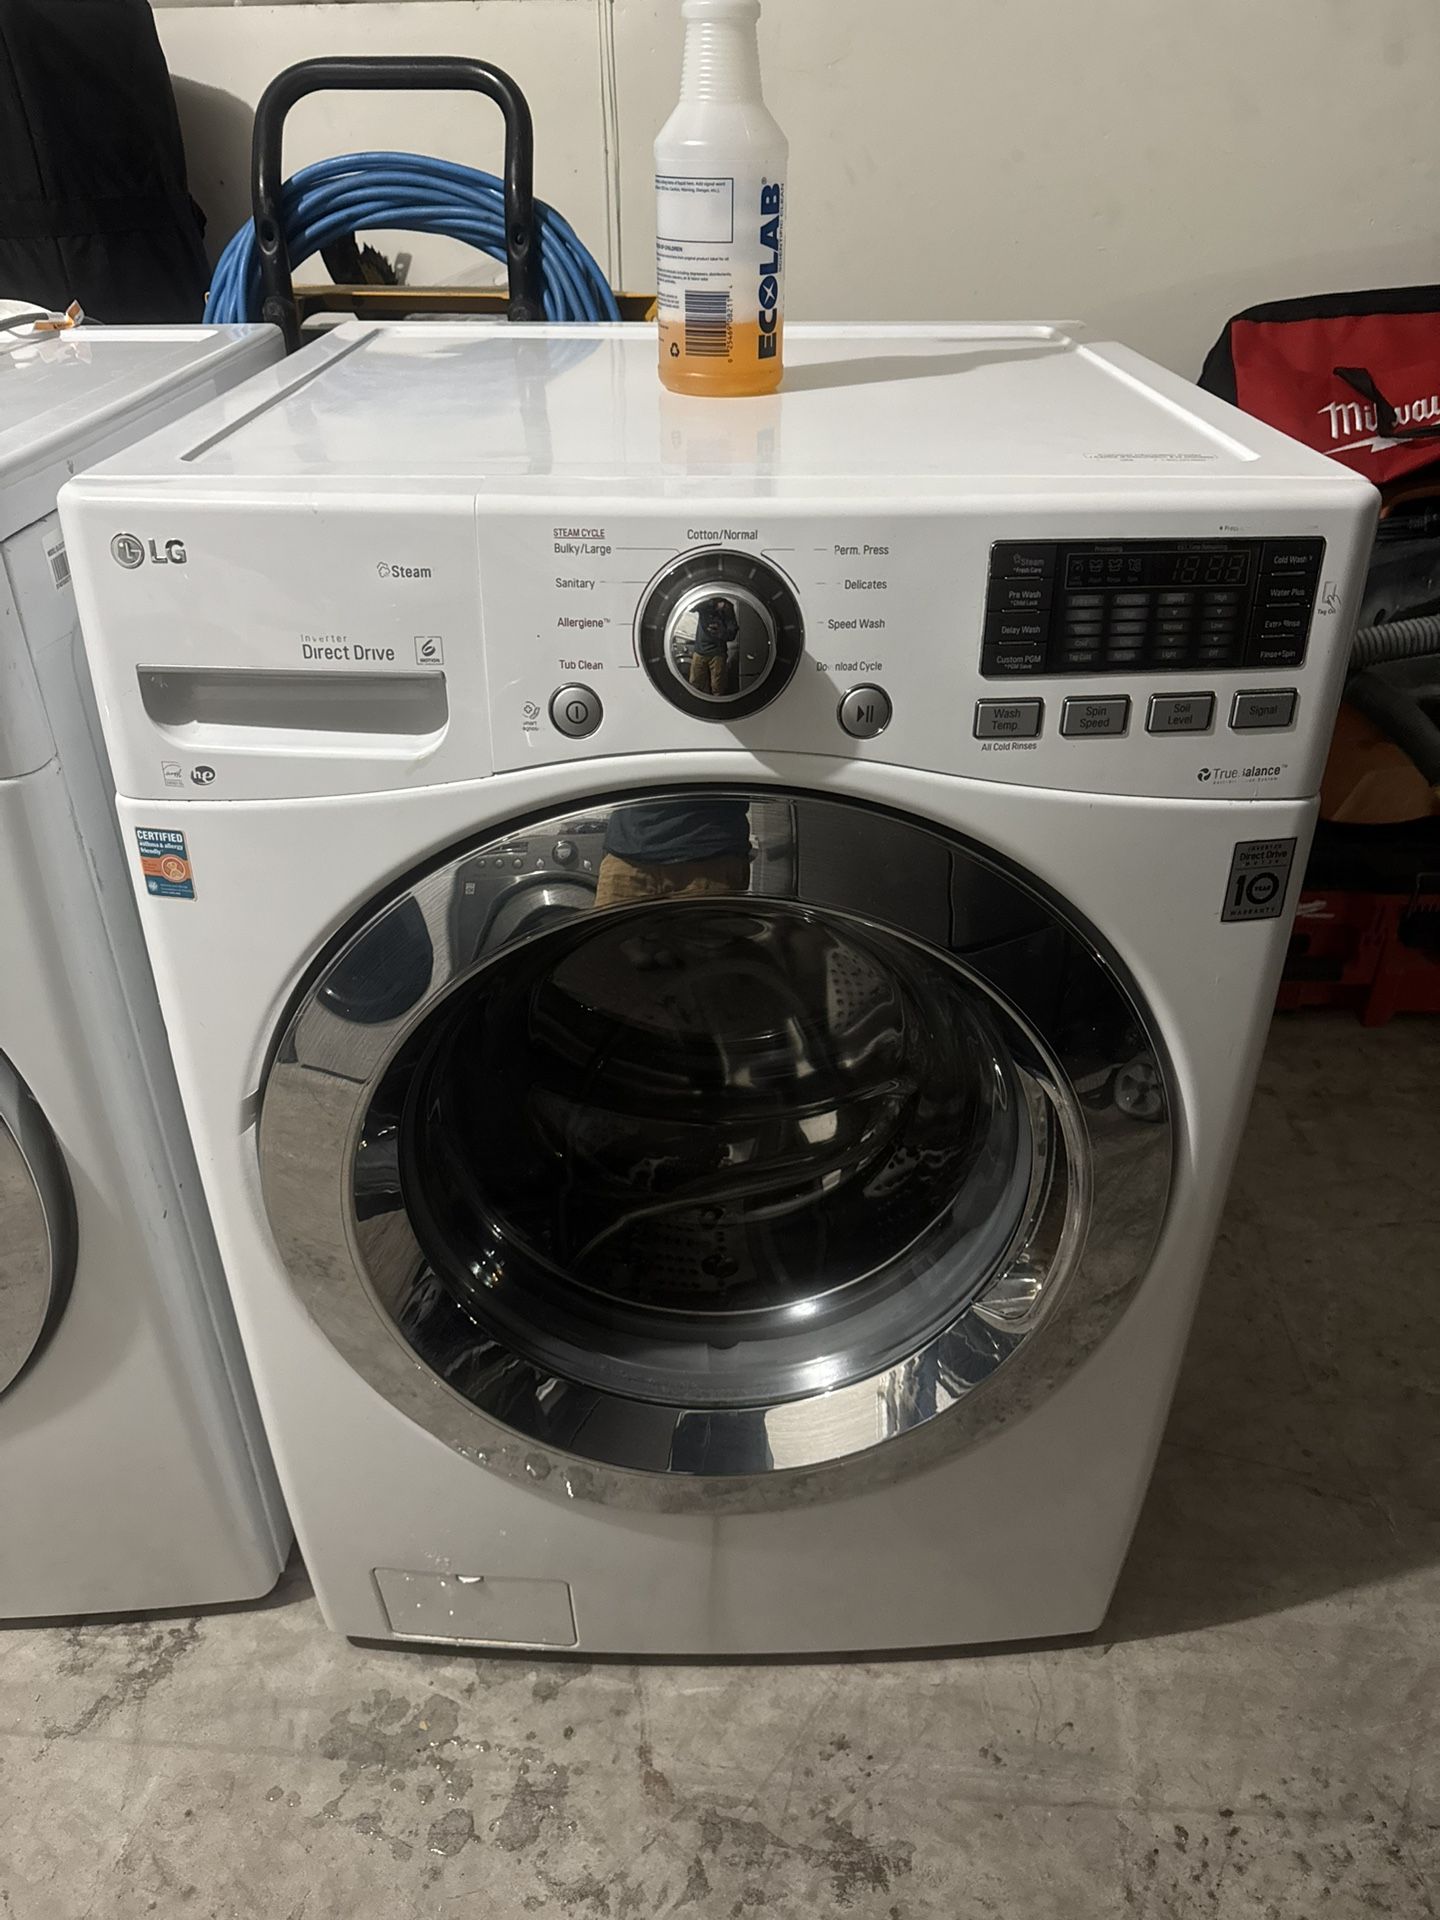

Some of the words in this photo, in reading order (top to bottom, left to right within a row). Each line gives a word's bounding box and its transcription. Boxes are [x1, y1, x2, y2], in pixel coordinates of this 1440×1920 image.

[553, 528, 580, 538] STEAM
[581, 528, 605, 538] CYCLE
[687, 529, 758, 540] Cotton/Normal
[148, 538, 187, 564] LG
[554, 543, 612, 556] Bulky/Large
[834, 545, 860, 556] Perm.
[863, 545, 889, 555] Press
[391, 565, 432, 578] Steam
[555, 578, 595, 590] Sanitary
[844, 579, 888, 590] Delicates
[1021, 590, 1041, 599] Wash
[1269, 588, 1291, 597] Water
[1291, 588, 1305, 597] Plus
[828, 618, 857, 631] Speed
[859, 618, 886, 629] Wash
[1001, 625, 1021, 636] Delay
[1021, 625, 1041, 634] Wash
[300, 634, 348, 643] Inverter
[302, 644, 351, 661] Direct
[353, 644, 396, 661] Drive
[996, 655, 1024, 664] Custom
[1024, 654, 1042, 663] PGM
[559, 660, 577, 670] Tub
[578, 660, 603, 670] Clean
[816, 661, 858, 671] Donload
[859, 661, 883, 672] Cycle
[993, 708, 1021, 719] Wash
[1085, 706, 1107, 717] Spin
[1173, 703, 1191, 714] Soil
[1249, 705, 1278, 717] Signal
[1079, 718, 1110, 729] Speed
[1167, 715, 1193, 725] Level
[981, 743, 992, 751] All
[993, 742, 1010, 751] Cold
[1011, 742, 1037, 751] Rinses
[1213, 768, 1238, 780] True
[136, 829, 183, 843] CERTIFIED
[1240, 851, 1265, 861] Direct
[1266, 850, 1288, 859] Drive
[1234, 872, 1280, 907] 10
